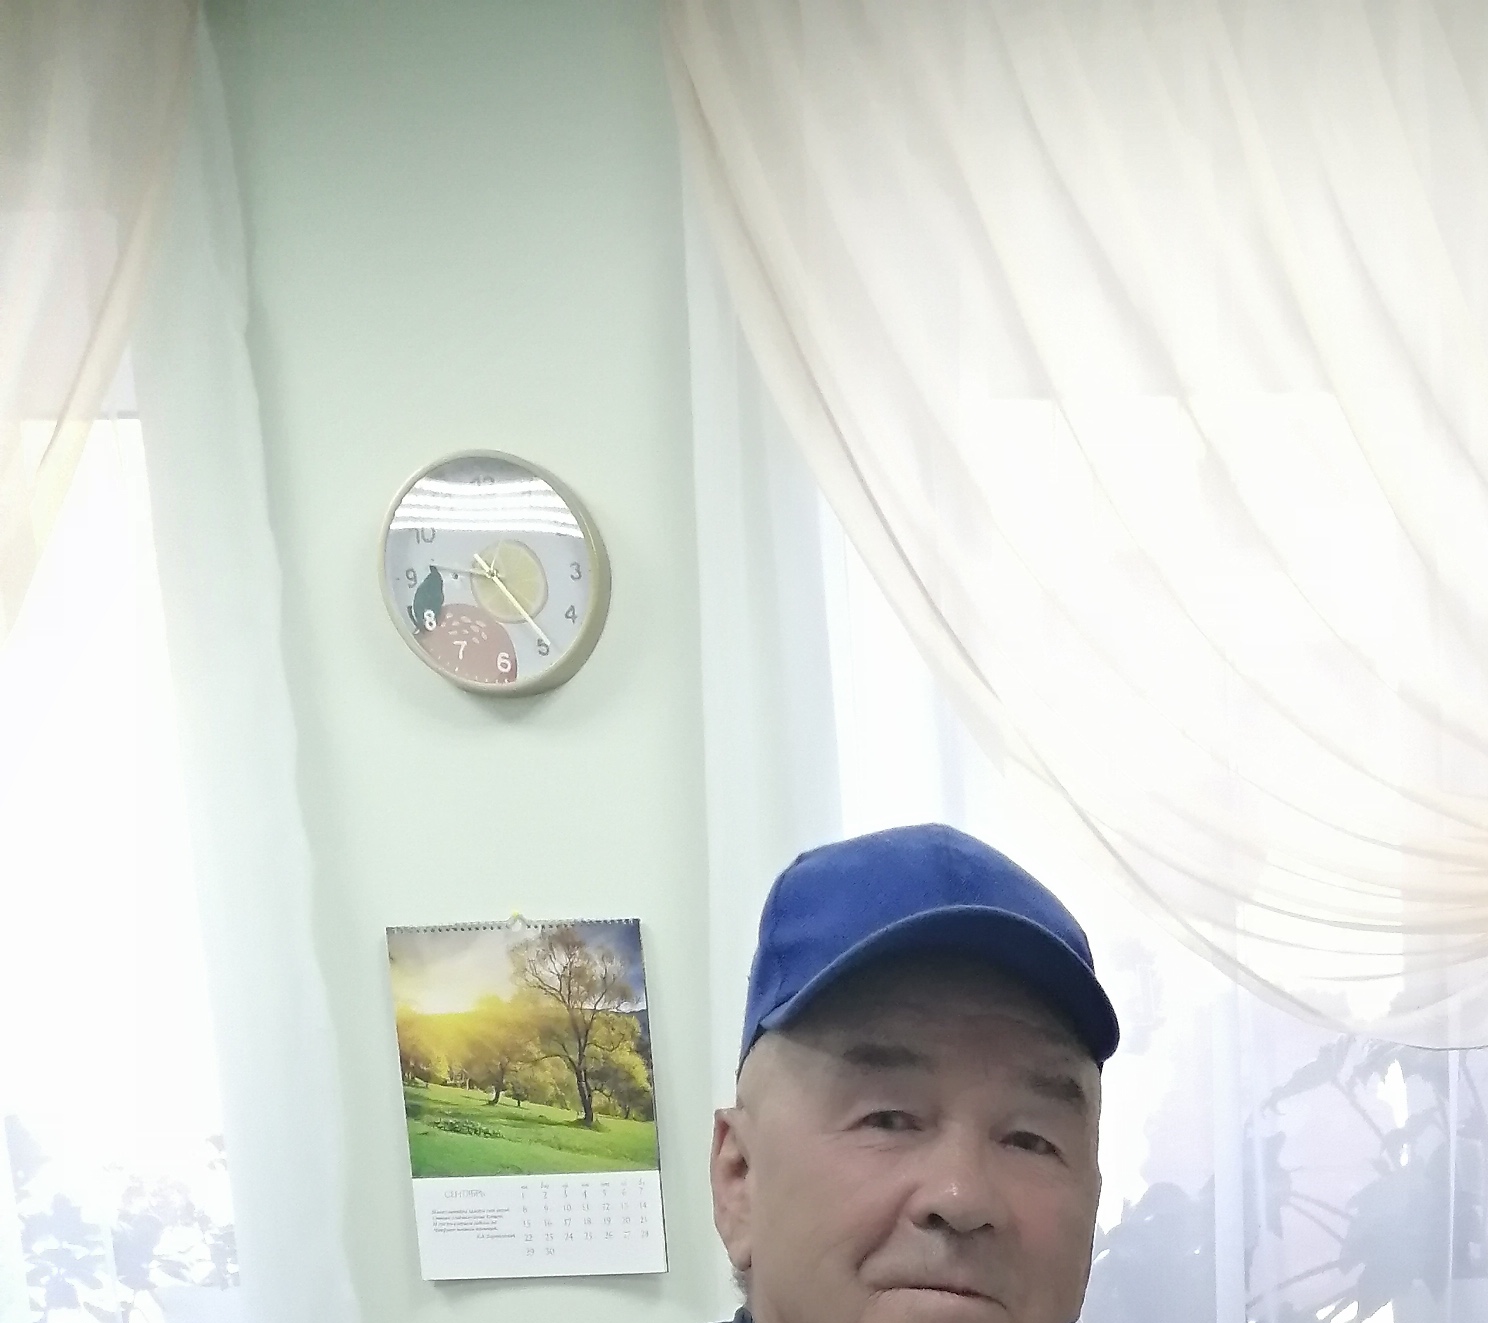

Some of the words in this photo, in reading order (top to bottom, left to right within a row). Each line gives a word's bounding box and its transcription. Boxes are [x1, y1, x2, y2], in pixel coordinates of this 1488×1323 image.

[405, 567, 418, 589] 9
[569, 561, 582, 581] 3
[423, 609, 437, 632] 8
[564, 604, 578, 624] 4
[453, 640, 467, 660] 7
[536, 638, 550, 657] 5
[496, 652, 512, 673] 6
